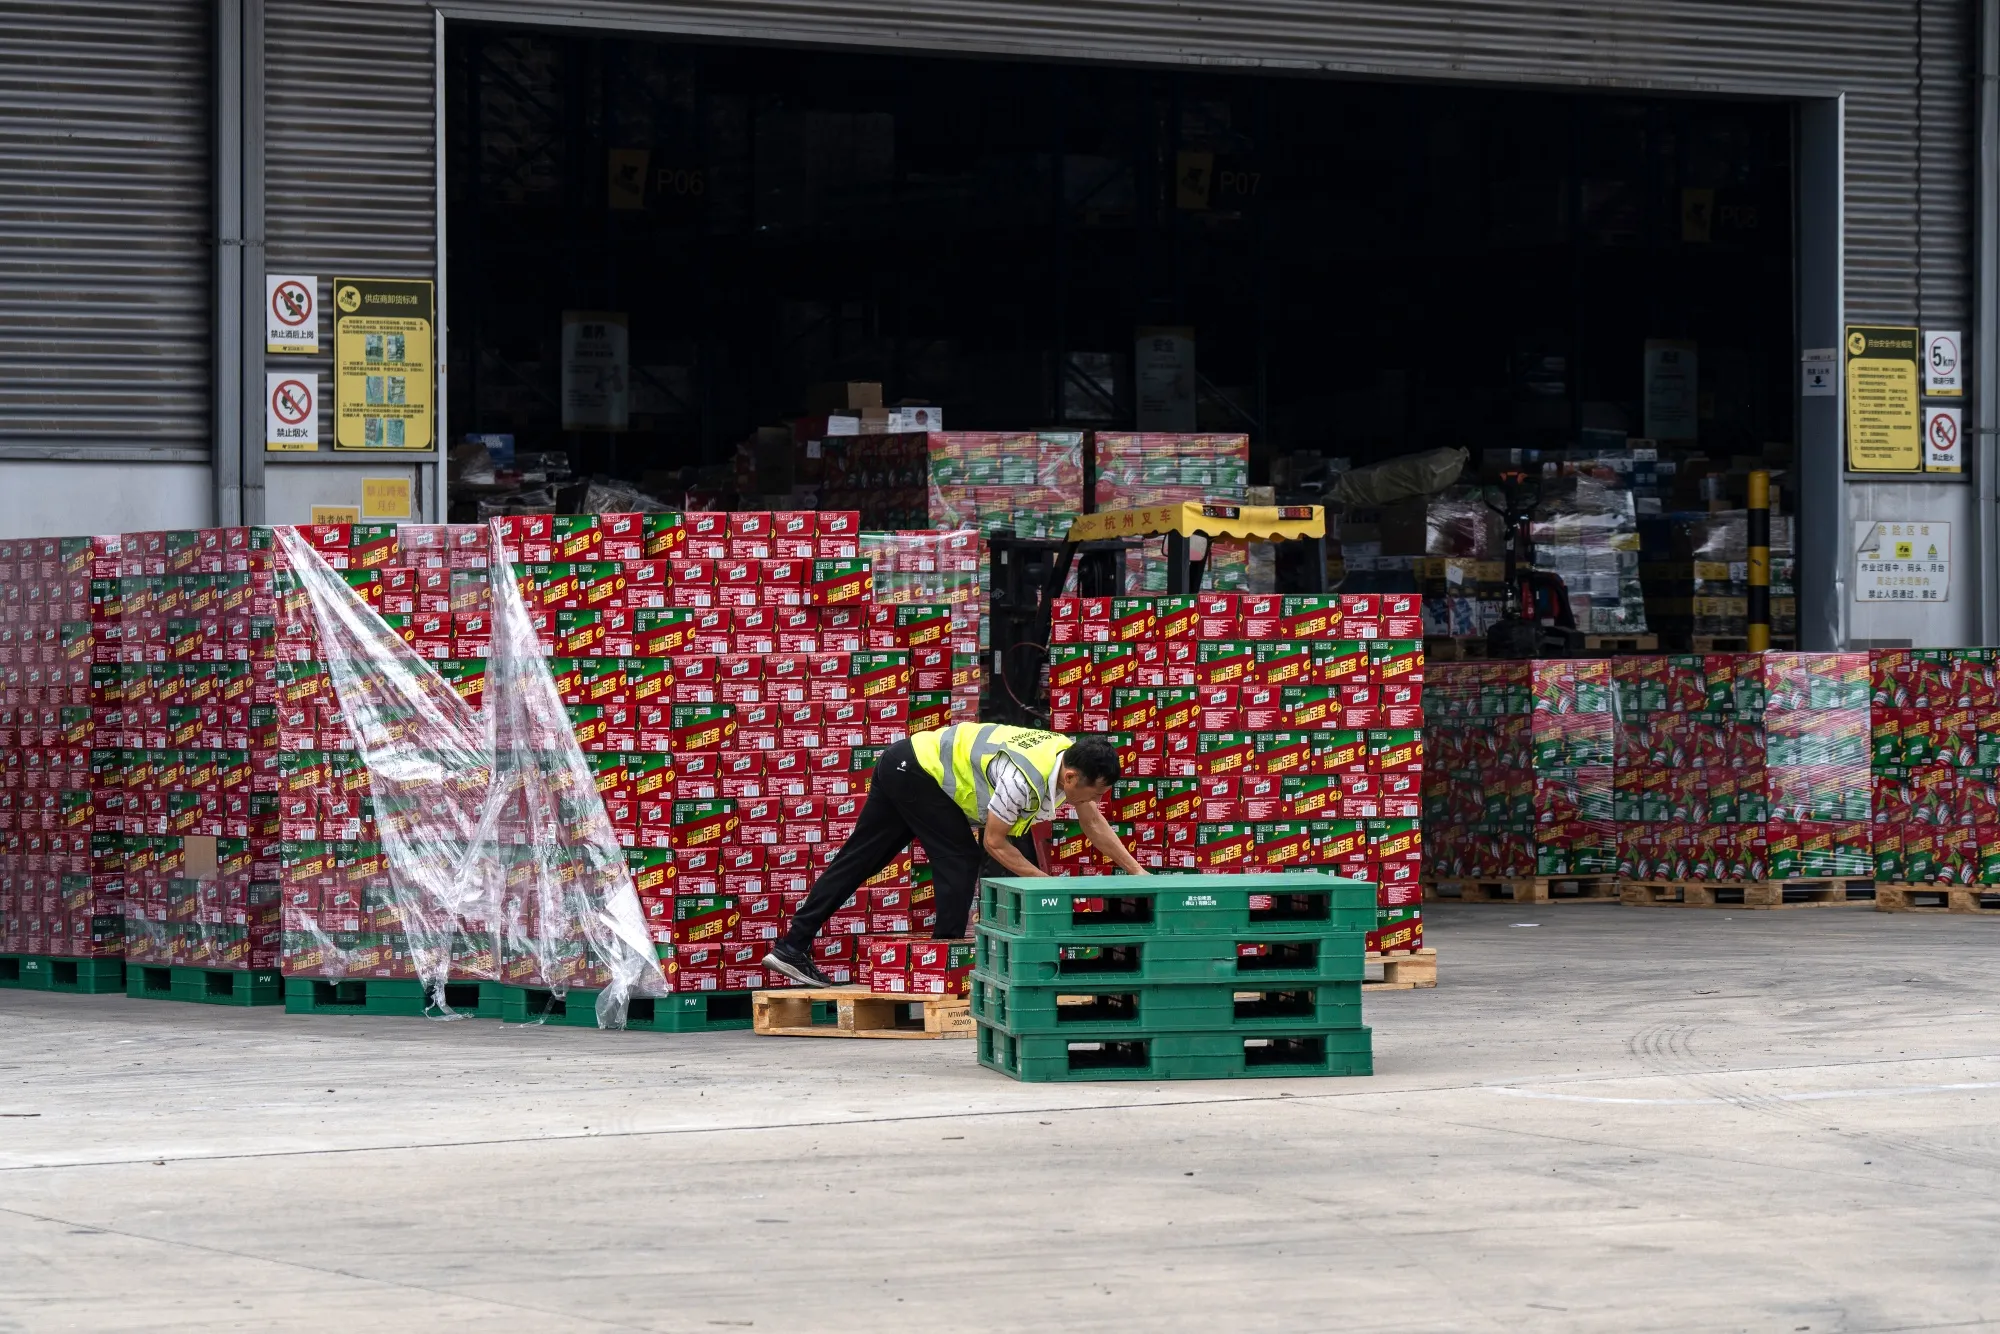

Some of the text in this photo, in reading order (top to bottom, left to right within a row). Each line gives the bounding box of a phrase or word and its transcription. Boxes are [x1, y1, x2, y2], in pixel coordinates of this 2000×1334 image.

[656, 170, 704, 196] P06
[1219, 170, 1261, 196] P07
[364, 293, 419, 305] 供应商卸货标准
[270, 329, 314, 340] 禁止酒后上岗
[276, 428, 309, 438] 禁止烟火
[1932, 453, 1955, 462] 禁止烟火
[377, 500, 397, 512] 月台
[1104, 508, 1172, 530] 杭州叉车
[1041, 897, 1059, 907] PW
[684, 998, 697, 1006] PW
